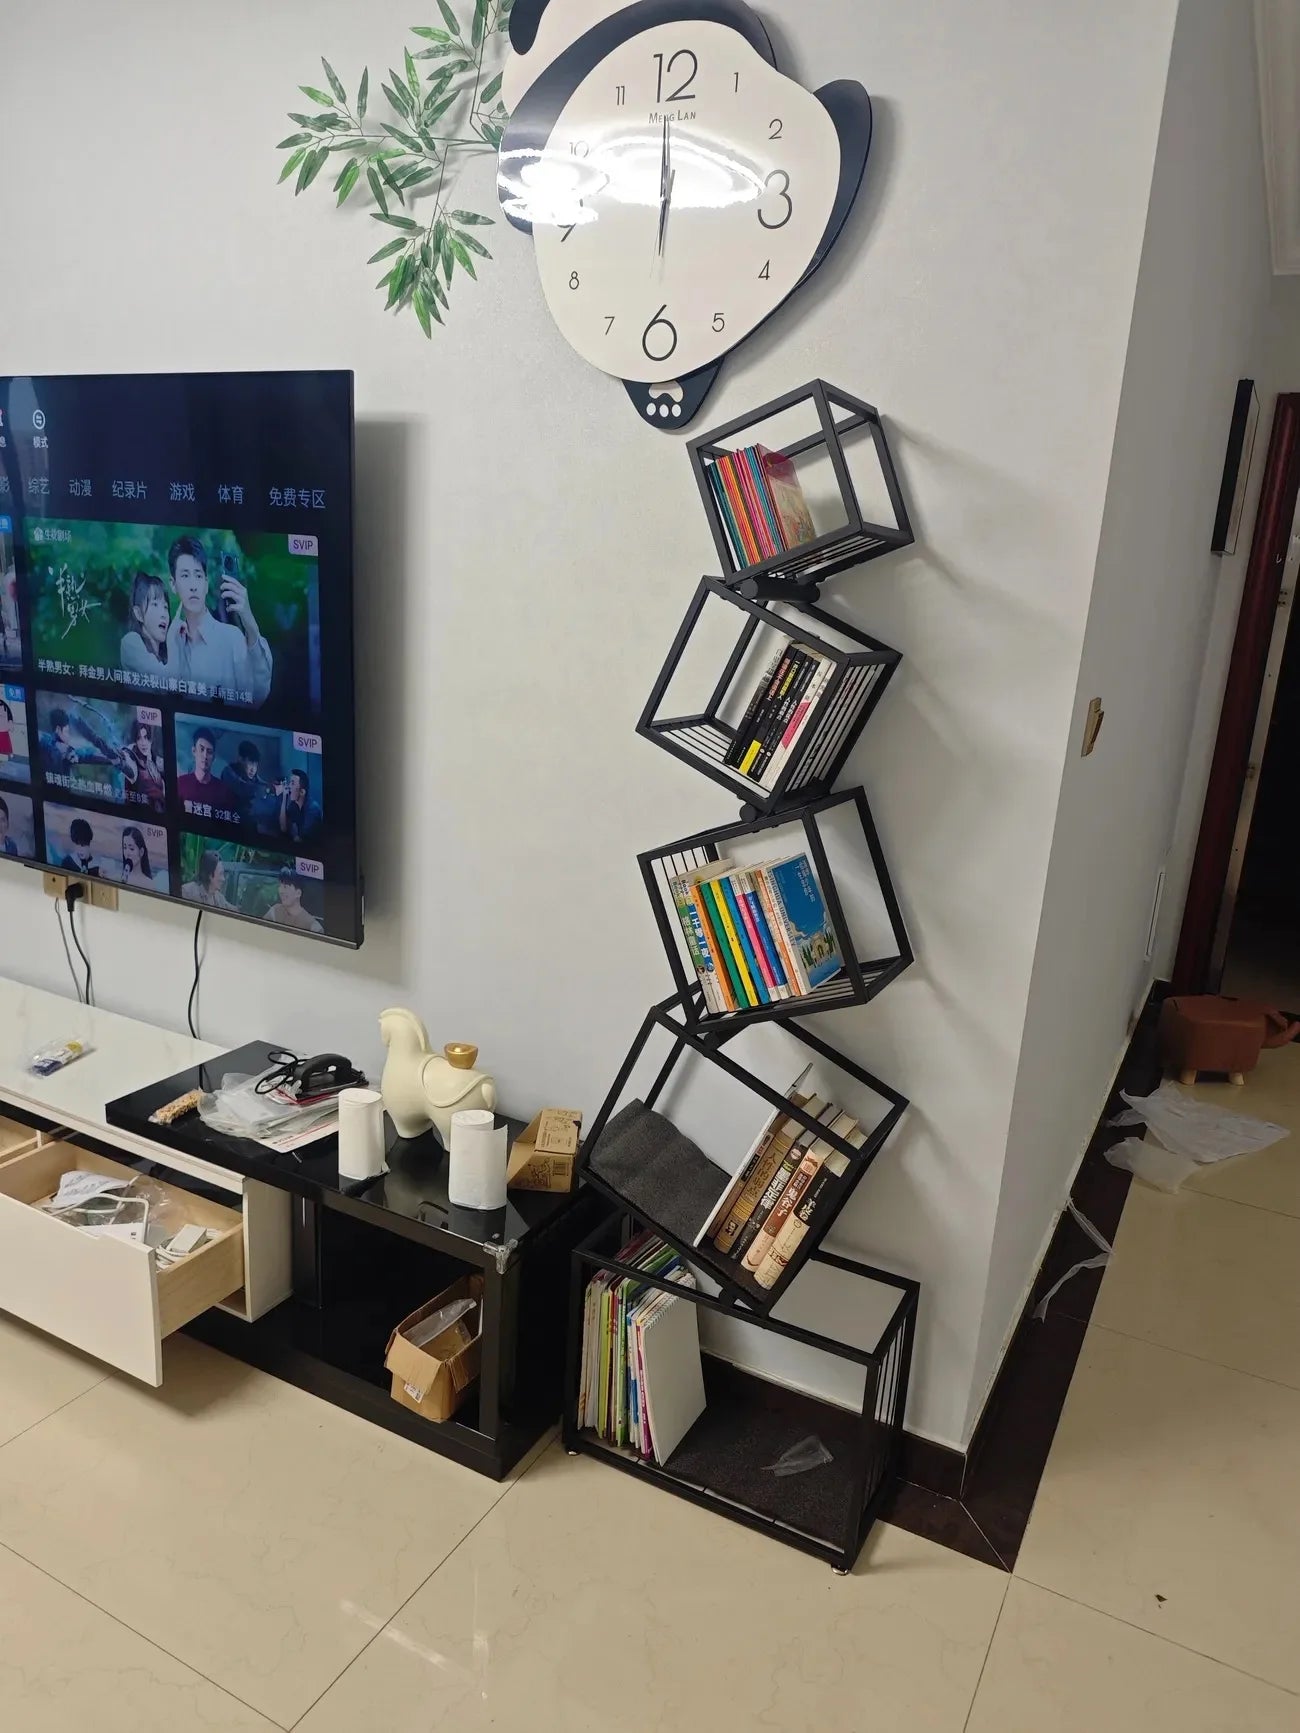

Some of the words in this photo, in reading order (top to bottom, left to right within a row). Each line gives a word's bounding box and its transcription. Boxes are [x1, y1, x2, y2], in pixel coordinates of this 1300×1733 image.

[653, 49, 699, 103] 12
[733, 72, 740, 93] 1
[615, 86, 625, 106] 11
[677, 109, 696, 121] LAN
[768, 119, 783, 140] 2
[757, 169, 793, 230] 3
[569, 271, 580, 290] 8
[758, 260, 771, 281] 4
[604, 316, 616, 336] 7
[641, 304, 678, 361] 6
[711, 313, 726, 332] 5
[33, 436, 49, 449] 模式
[28, 477, 50, 496] 综艺
[69, 478, 93, 498] 动漫
[112, 479, 148, 500] 纪录片
[169, 481, 196, 503] 游戏
[218, 484, 244, 505] 体育
[268, 486, 327, 509] 免费专区
[292, 538, 314, 551] SVIP
[140, 709, 158, 720] SVIP
[297, 736, 318, 748] SVIP
[215, 809, 241, 824] 32集全
[146, 827, 164, 837] SVIP
[300, 861, 319, 874] SVIP
[745, 1152, 776, 1200] 人性的弱点
[777, 1187, 799, 1217] 鬼谷子
